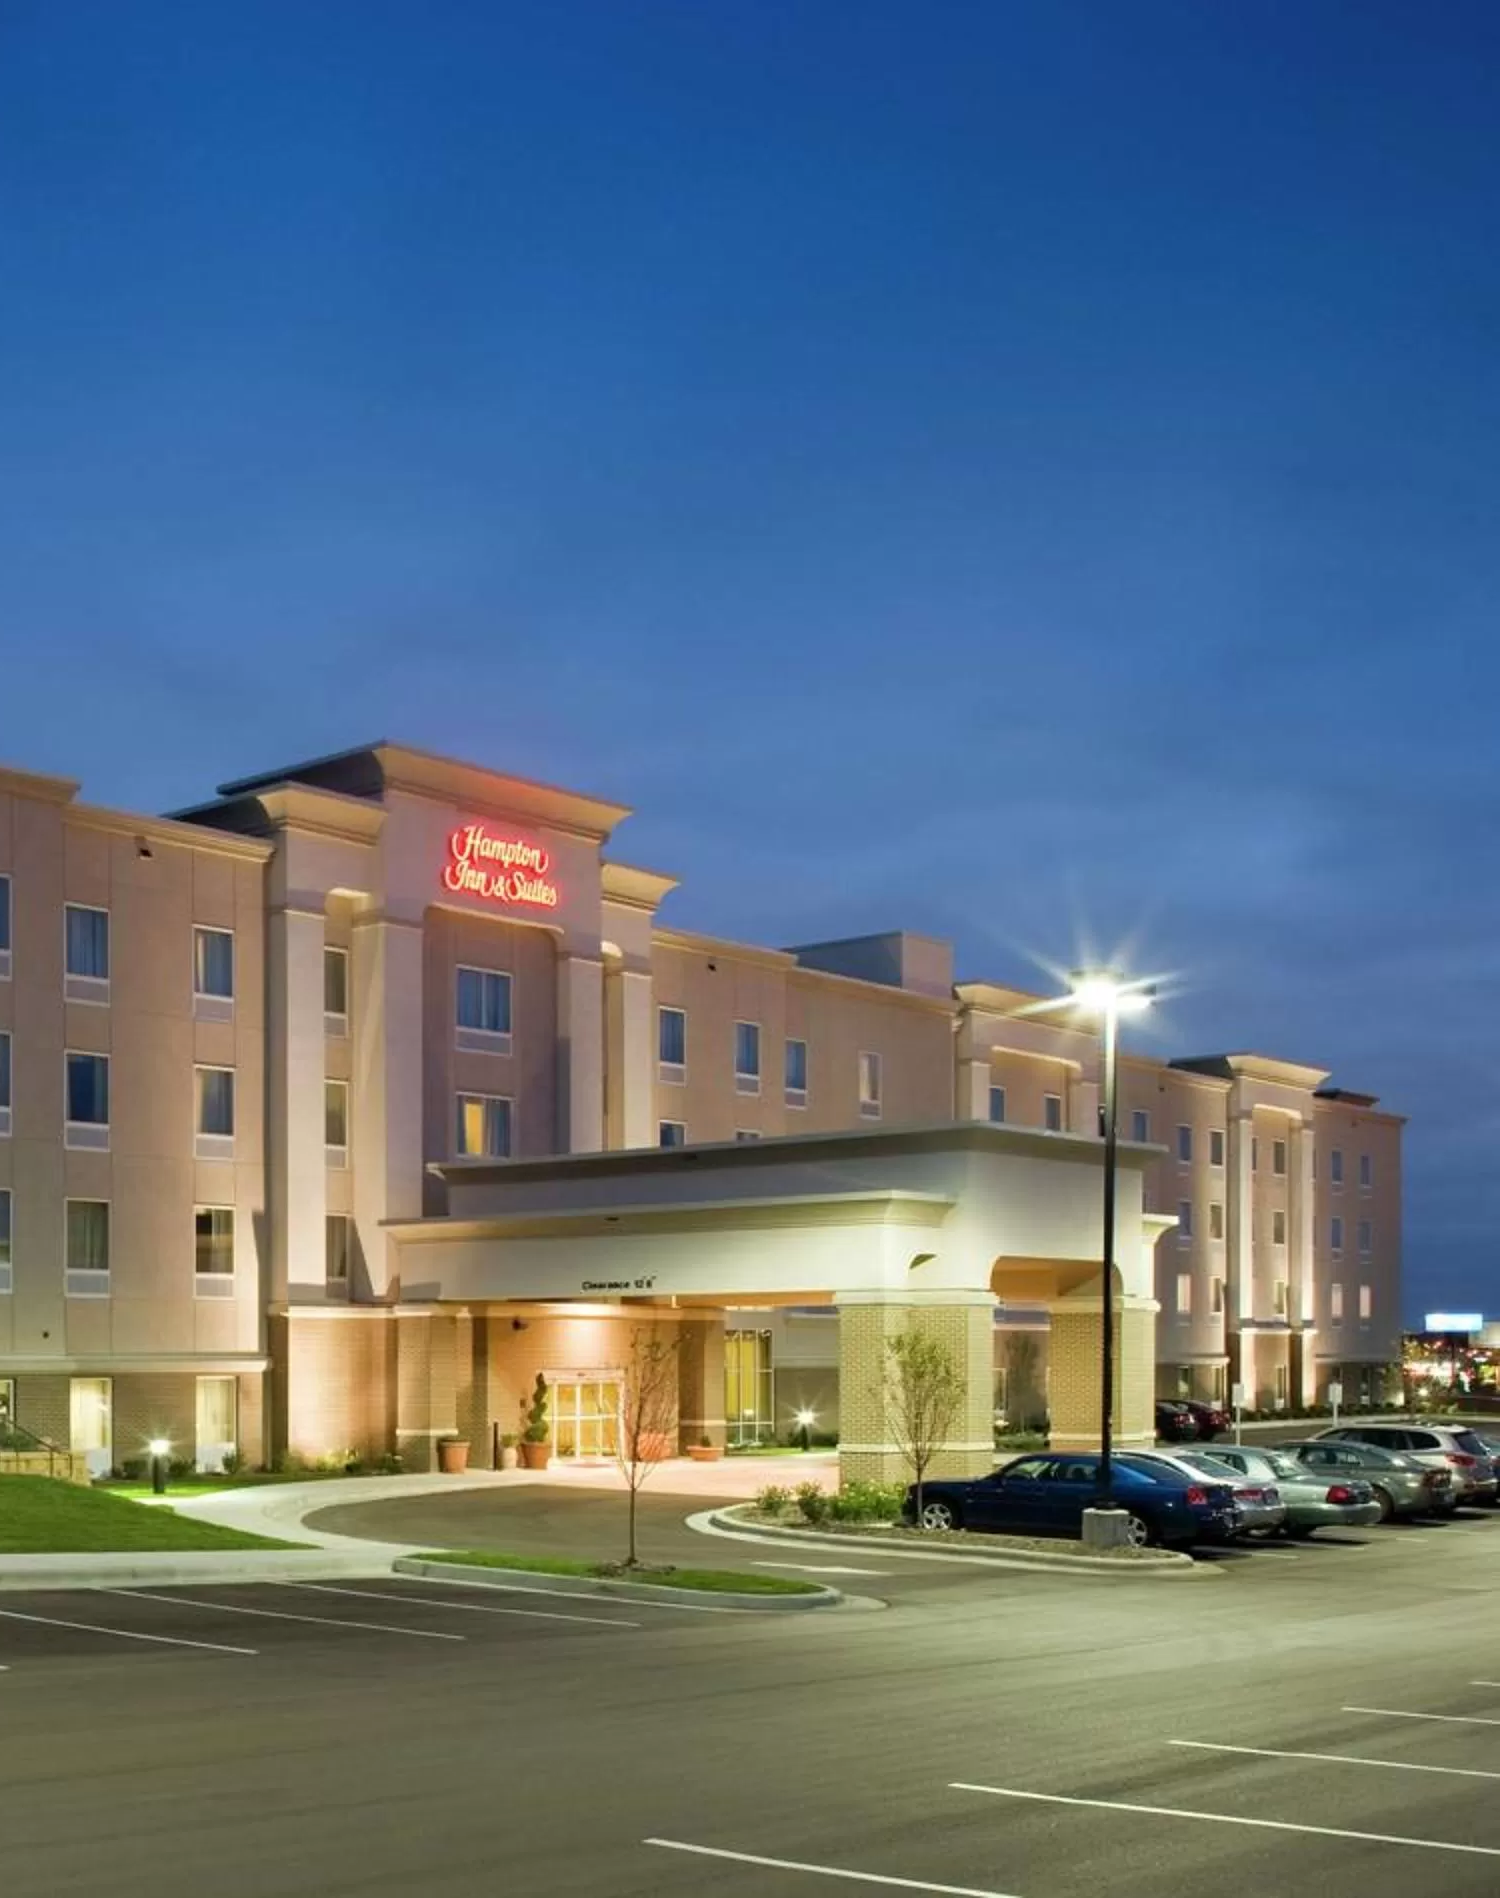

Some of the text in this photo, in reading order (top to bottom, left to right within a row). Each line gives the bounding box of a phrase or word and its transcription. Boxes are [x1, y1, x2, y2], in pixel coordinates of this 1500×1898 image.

[452, 826, 548, 872] Hampton
[445, 860, 557, 906] Inn & Suites
